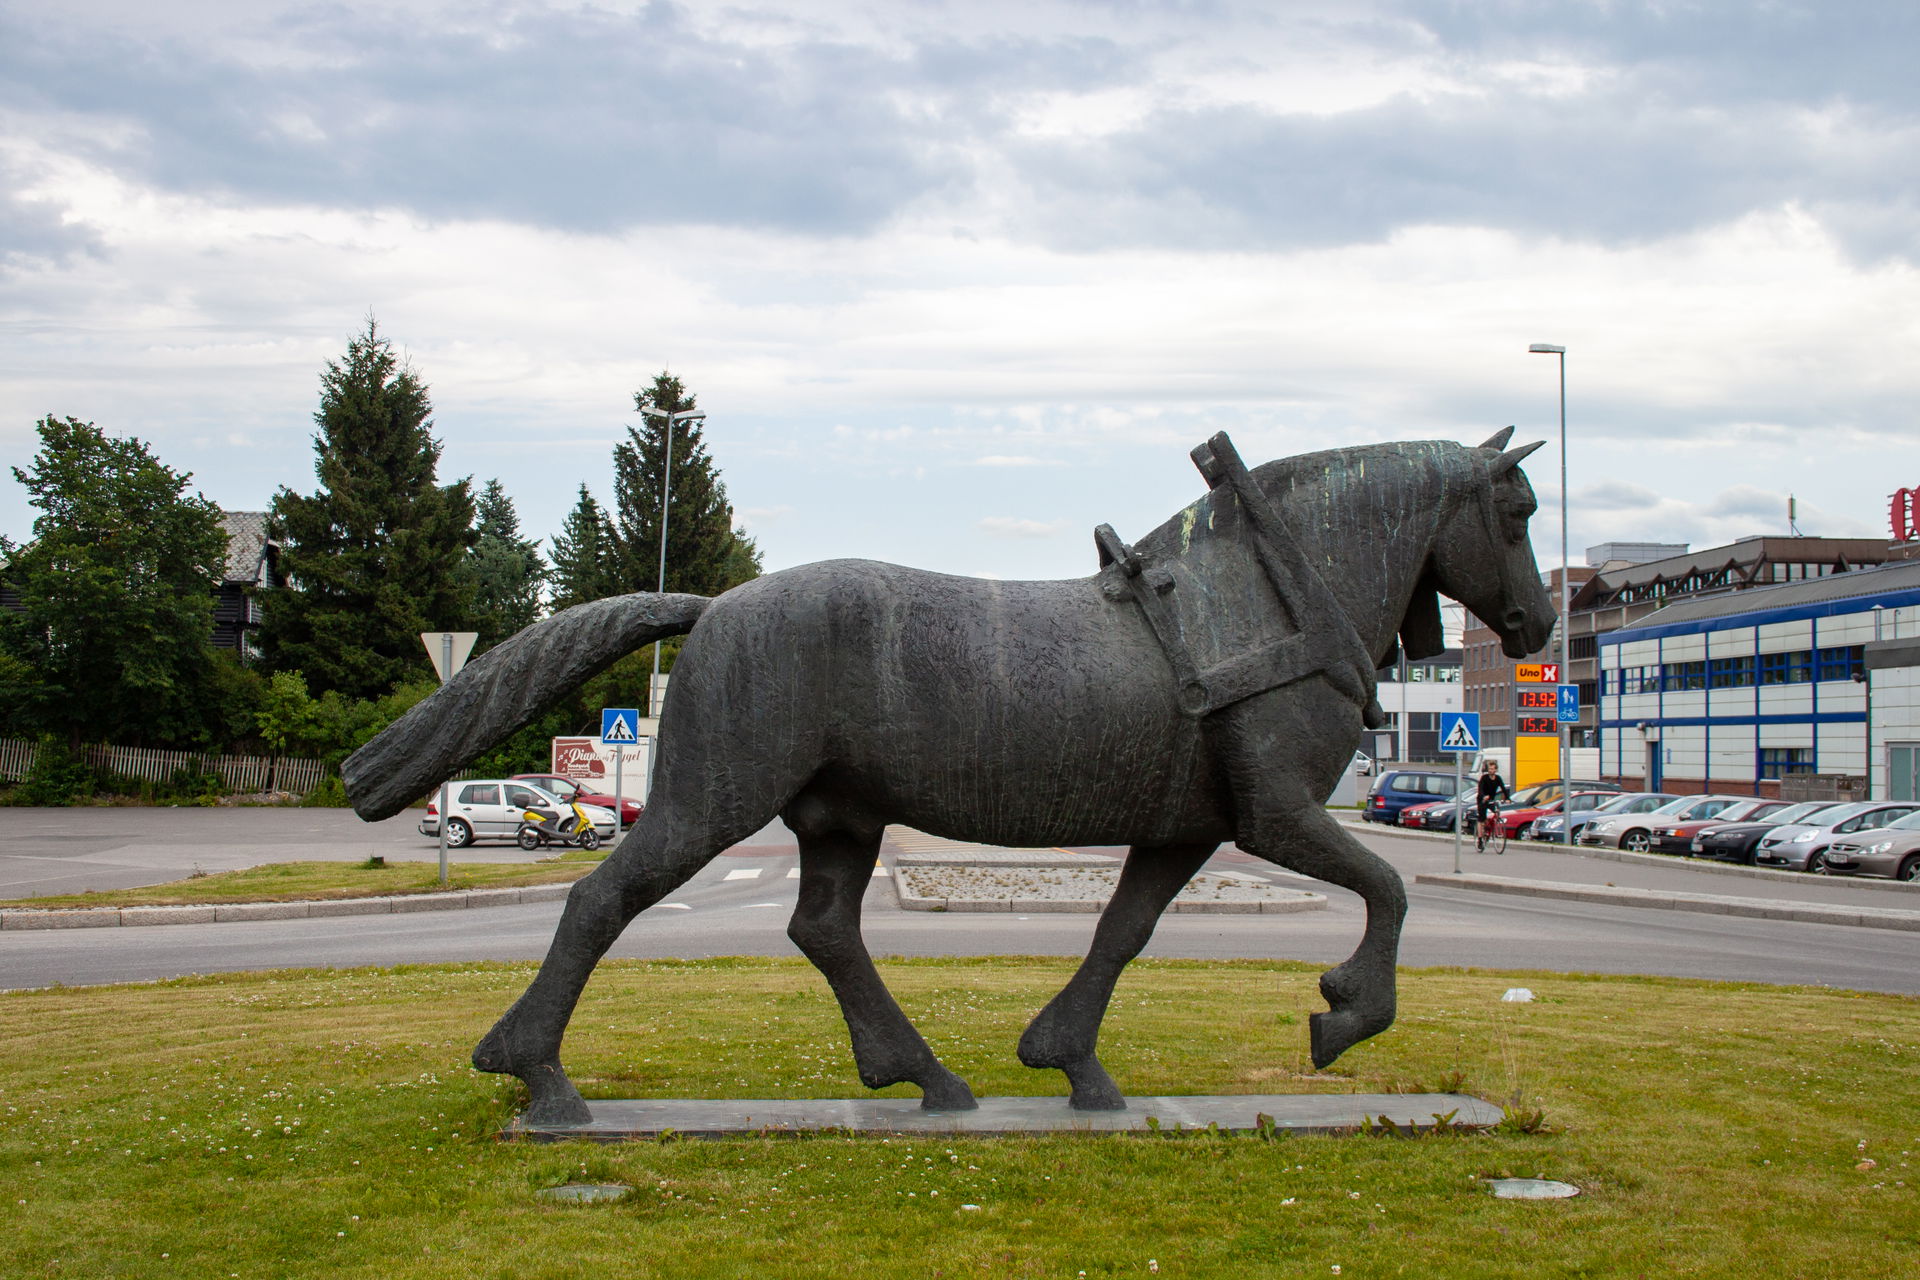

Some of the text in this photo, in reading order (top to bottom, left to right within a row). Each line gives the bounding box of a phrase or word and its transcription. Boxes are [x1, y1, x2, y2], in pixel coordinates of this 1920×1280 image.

[1519, 665, 1557, 681] Uno X
[1523, 692, 1557, 707] 13.92
[1523, 718, 1557, 732] 15.27
[606, 749, 641, 762] Fygel
